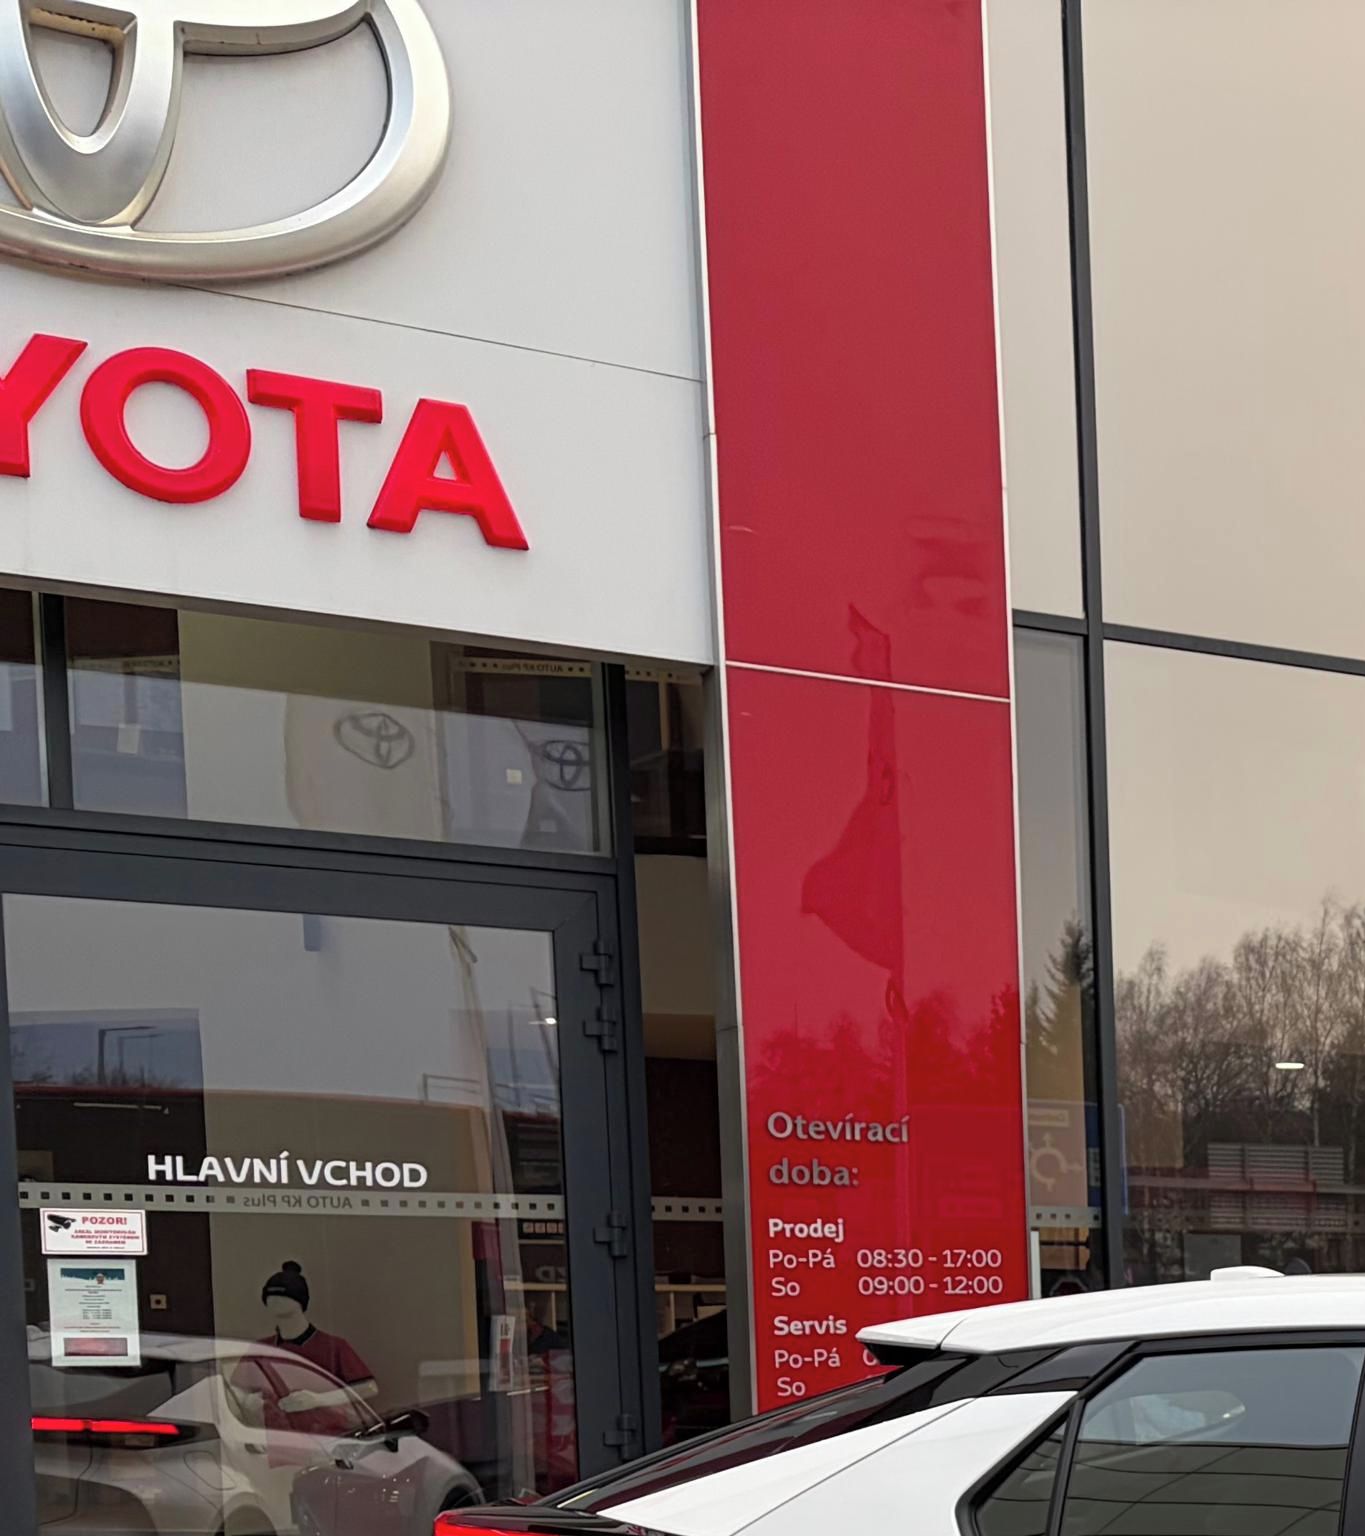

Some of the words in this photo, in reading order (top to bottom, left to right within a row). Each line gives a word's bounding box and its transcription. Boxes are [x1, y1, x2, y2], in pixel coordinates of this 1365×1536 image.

[767, 1111, 911, 1144] Otevírací
[147, 1150, 290, 1184] HLAVNÍ
[296, 1159, 428, 1188] VCHOD
[769, 1158, 860, 1187] doba:
[82, 1216, 128, 1225] POZOR!
[768, 1218, 845, 1242] Prodej
[768, 1248, 836, 1269] Po-Pá
[856, 1248, 923, 1269] 08:30
[942, 1248, 1002, 1268] 17:00
[771, 1276, 800, 1297] So
[858, 1276, 925, 1296] 09:00
[943, 1275, 1003, 1295] 12:00
[773, 1315, 847, 1336] Servis
[774, 1347, 841, 1369] Po-Pá
[777, 1377, 806, 1397] So
